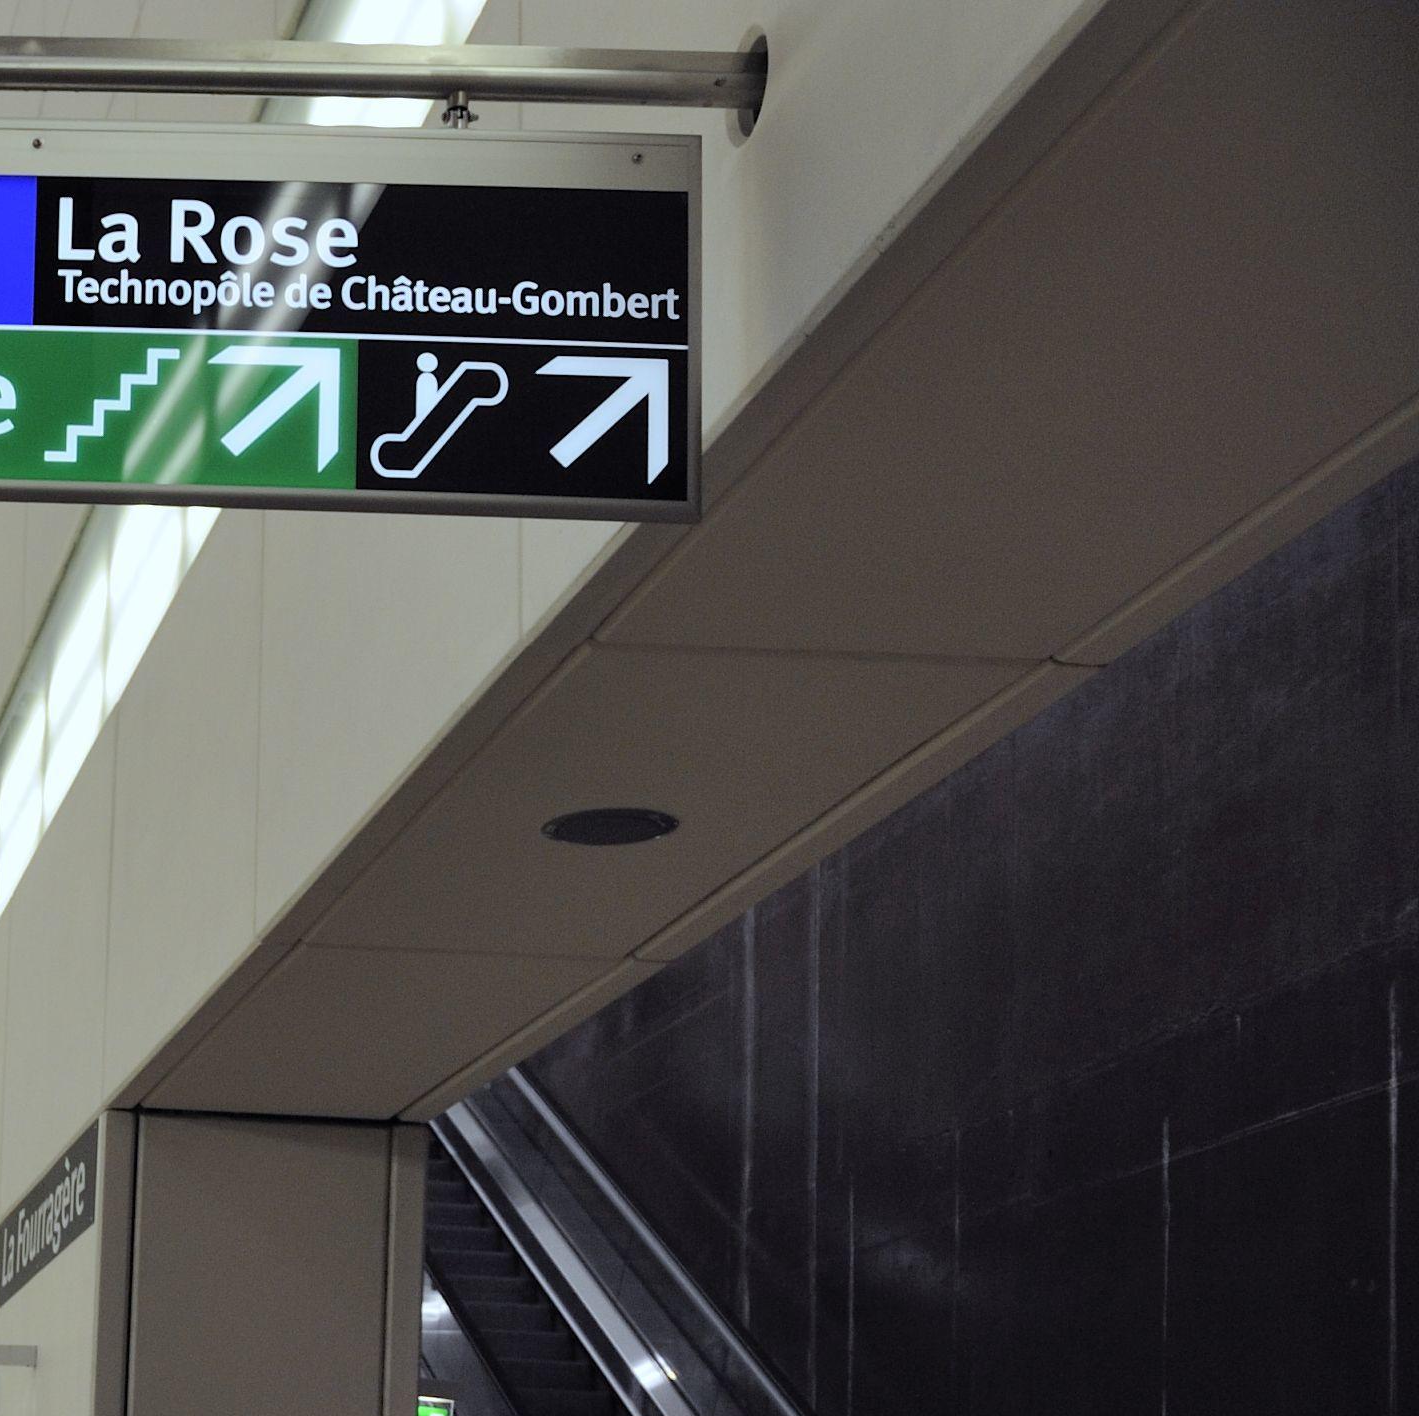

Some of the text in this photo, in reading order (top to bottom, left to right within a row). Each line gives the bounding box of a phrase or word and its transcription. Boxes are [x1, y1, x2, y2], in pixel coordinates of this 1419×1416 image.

[58, 197, 360, 270] La Rose
[57, 267, 681, 322] Technopôle de Château-Gombert
[1, 1156, 86, 1288] La Fourragère
